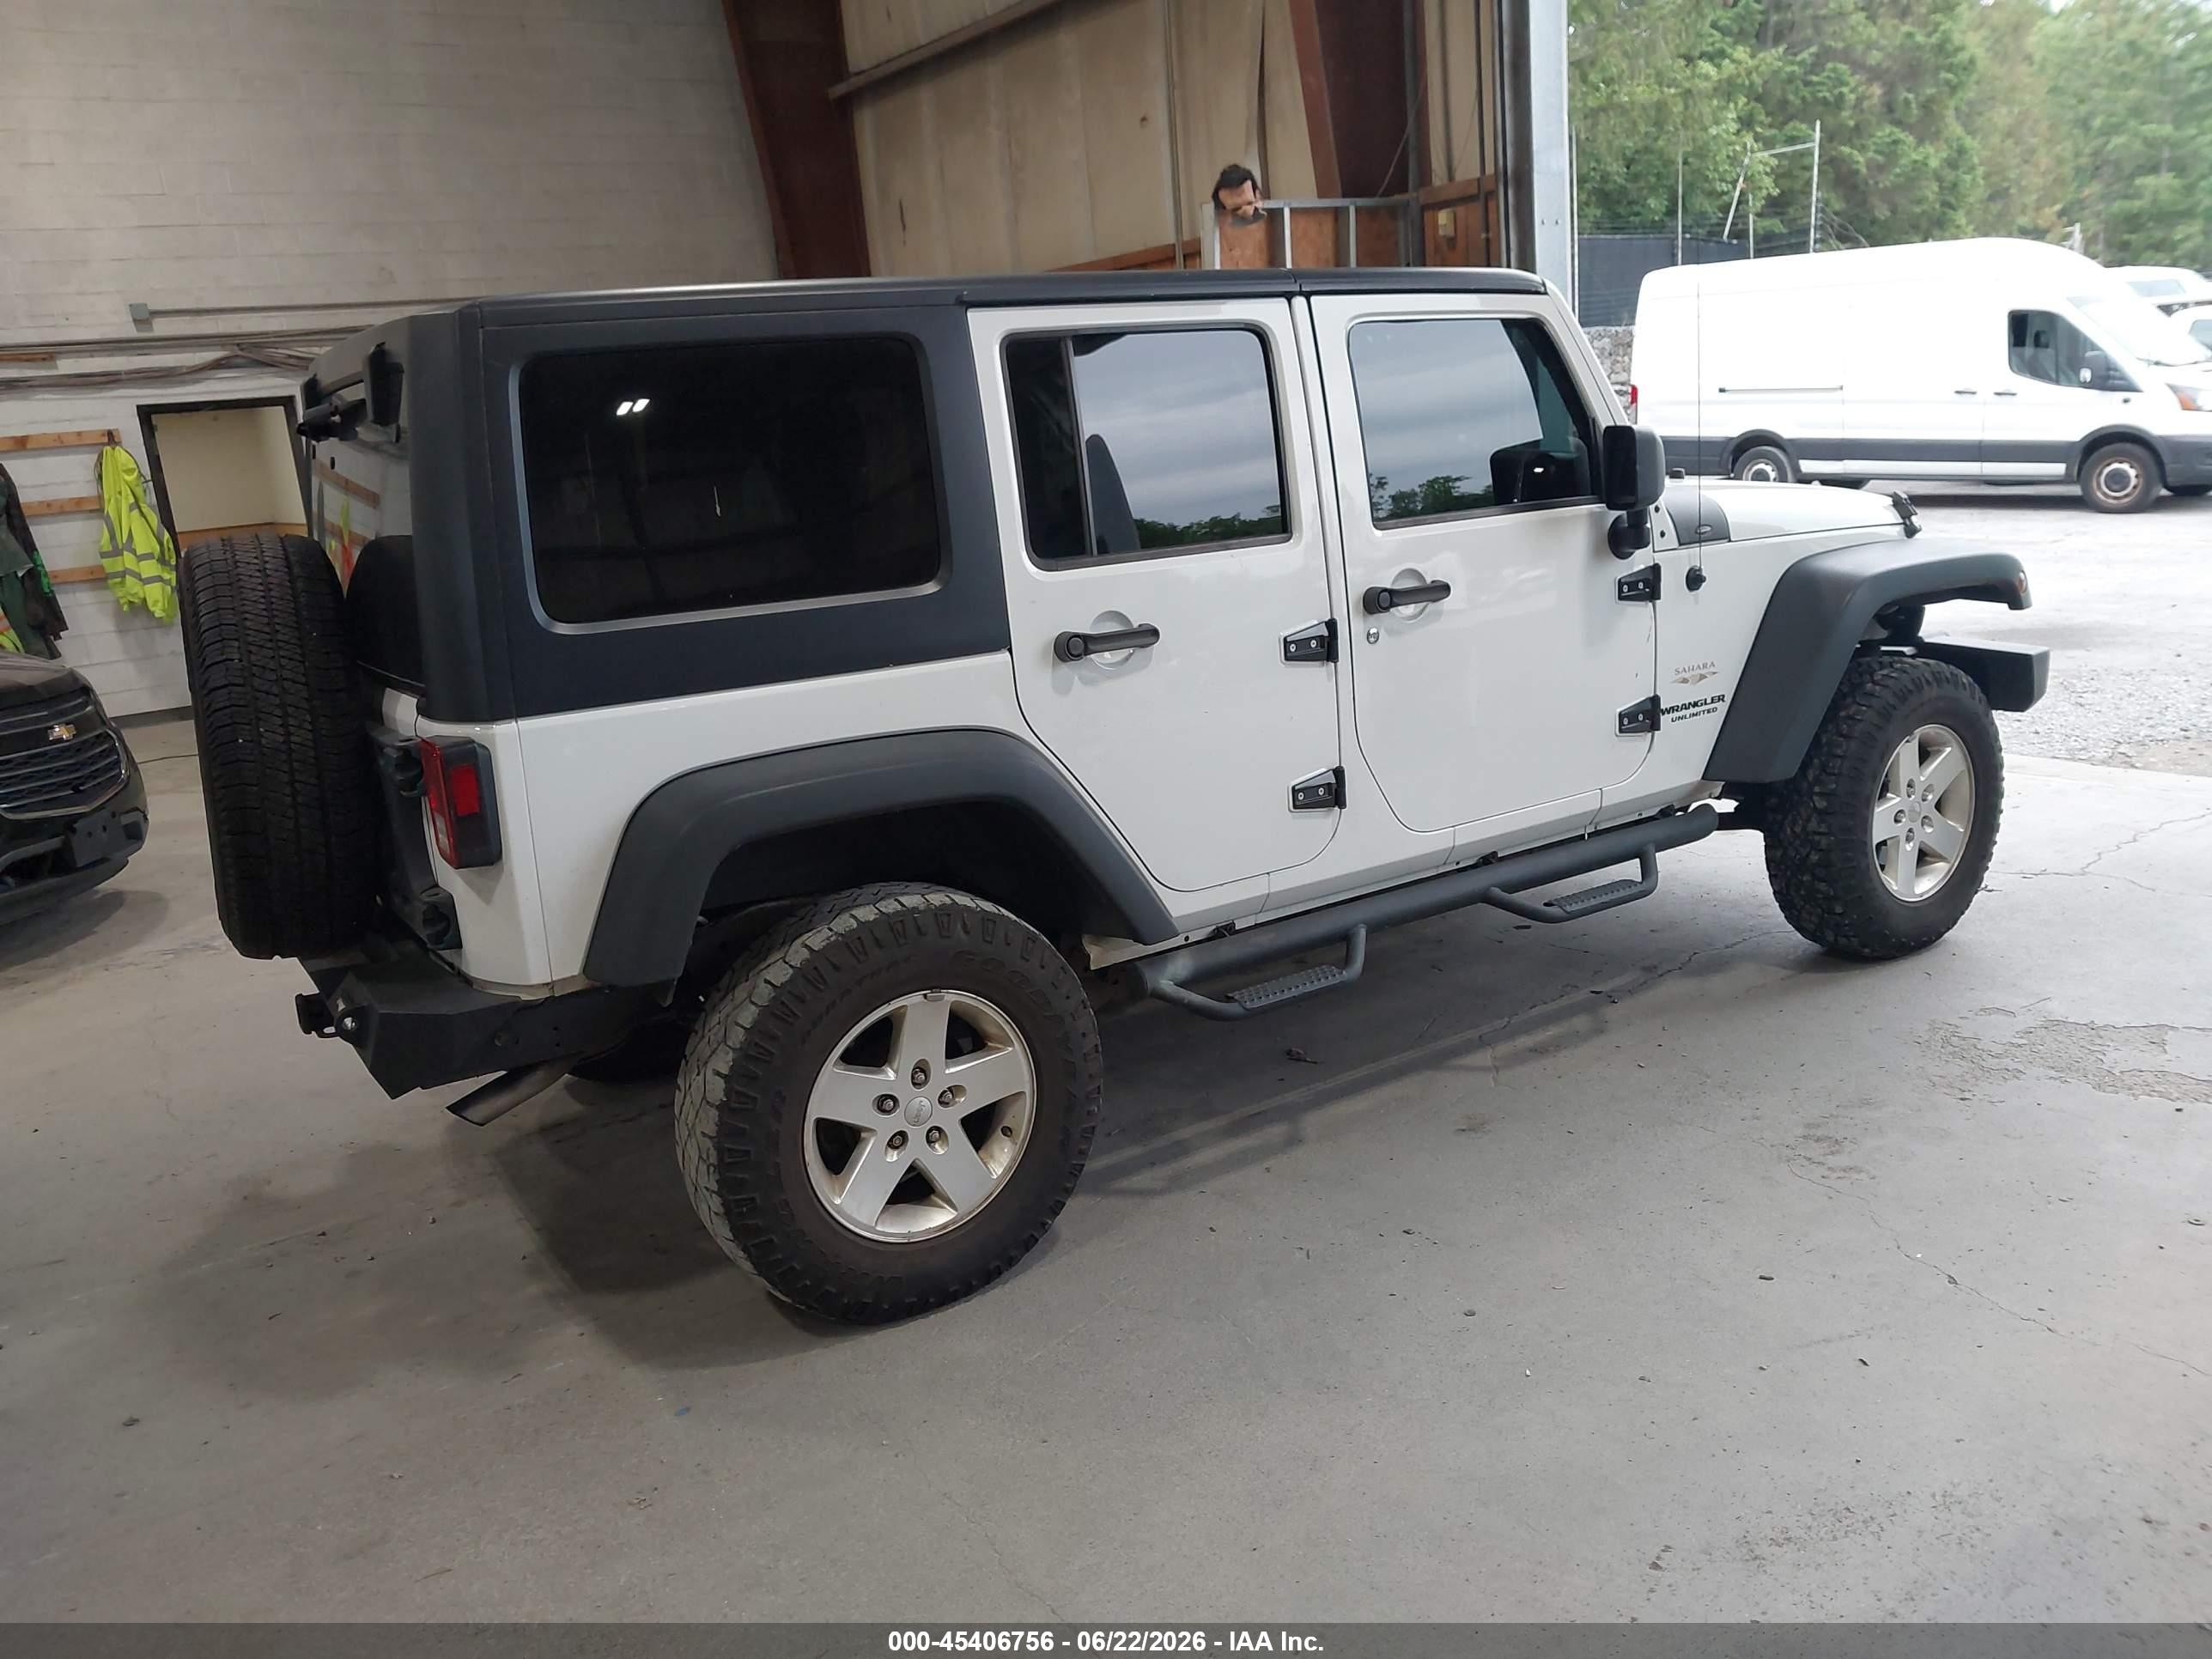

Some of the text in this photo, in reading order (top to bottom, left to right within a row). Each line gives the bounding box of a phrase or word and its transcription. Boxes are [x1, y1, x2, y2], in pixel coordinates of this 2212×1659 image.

[1674, 660, 1716, 676] SAHARA
[1661, 694, 1725, 716] WRANGLER
[1671, 707, 1717, 722] UNLIMITED
